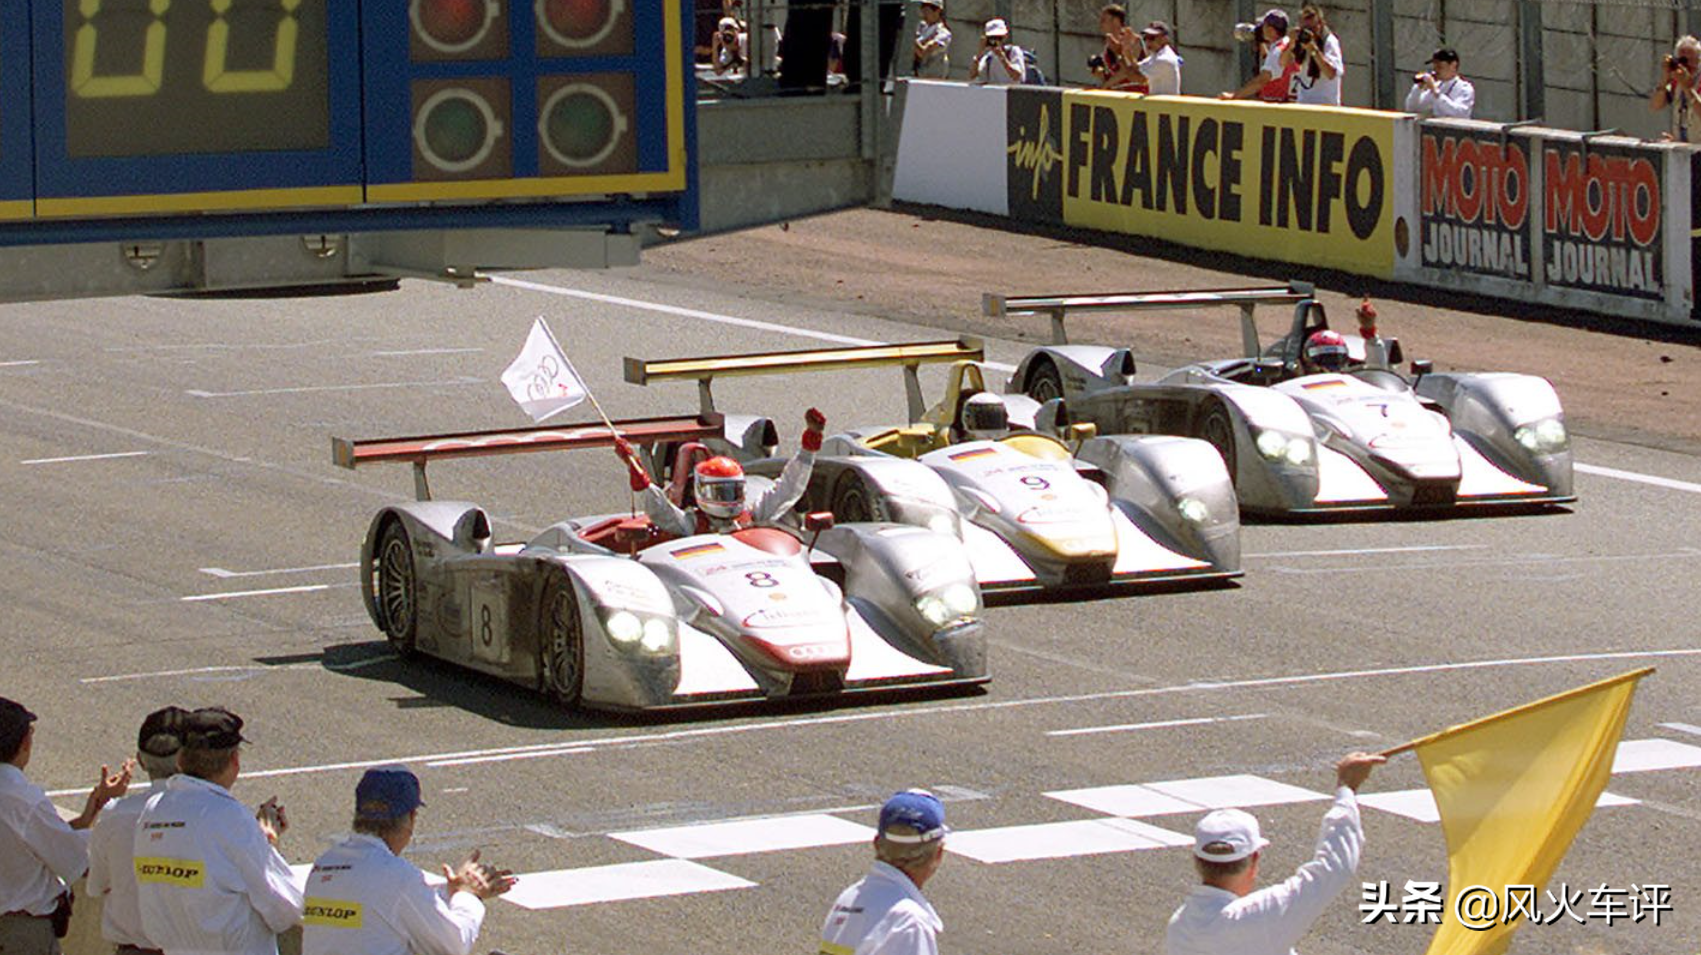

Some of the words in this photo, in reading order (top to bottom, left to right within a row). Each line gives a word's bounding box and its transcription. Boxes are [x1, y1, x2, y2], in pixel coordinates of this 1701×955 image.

[1006, 103, 1063, 201] info
[1067, 103, 1244, 223] FRANCE
[1259, 125, 1384, 241] INFO
[1422, 134, 1529, 231] MOTO
[1544, 148, 1661, 246] MOTO
[1424, 222, 1529, 276] JOURNAL
[1547, 240, 1661, 291] JOURNAL
[1366, 403, 1388, 417] 7
[1019, 475, 1050, 490] 9
[745, 571, 779, 588] 8
[481, 603, 493, 647] 8
